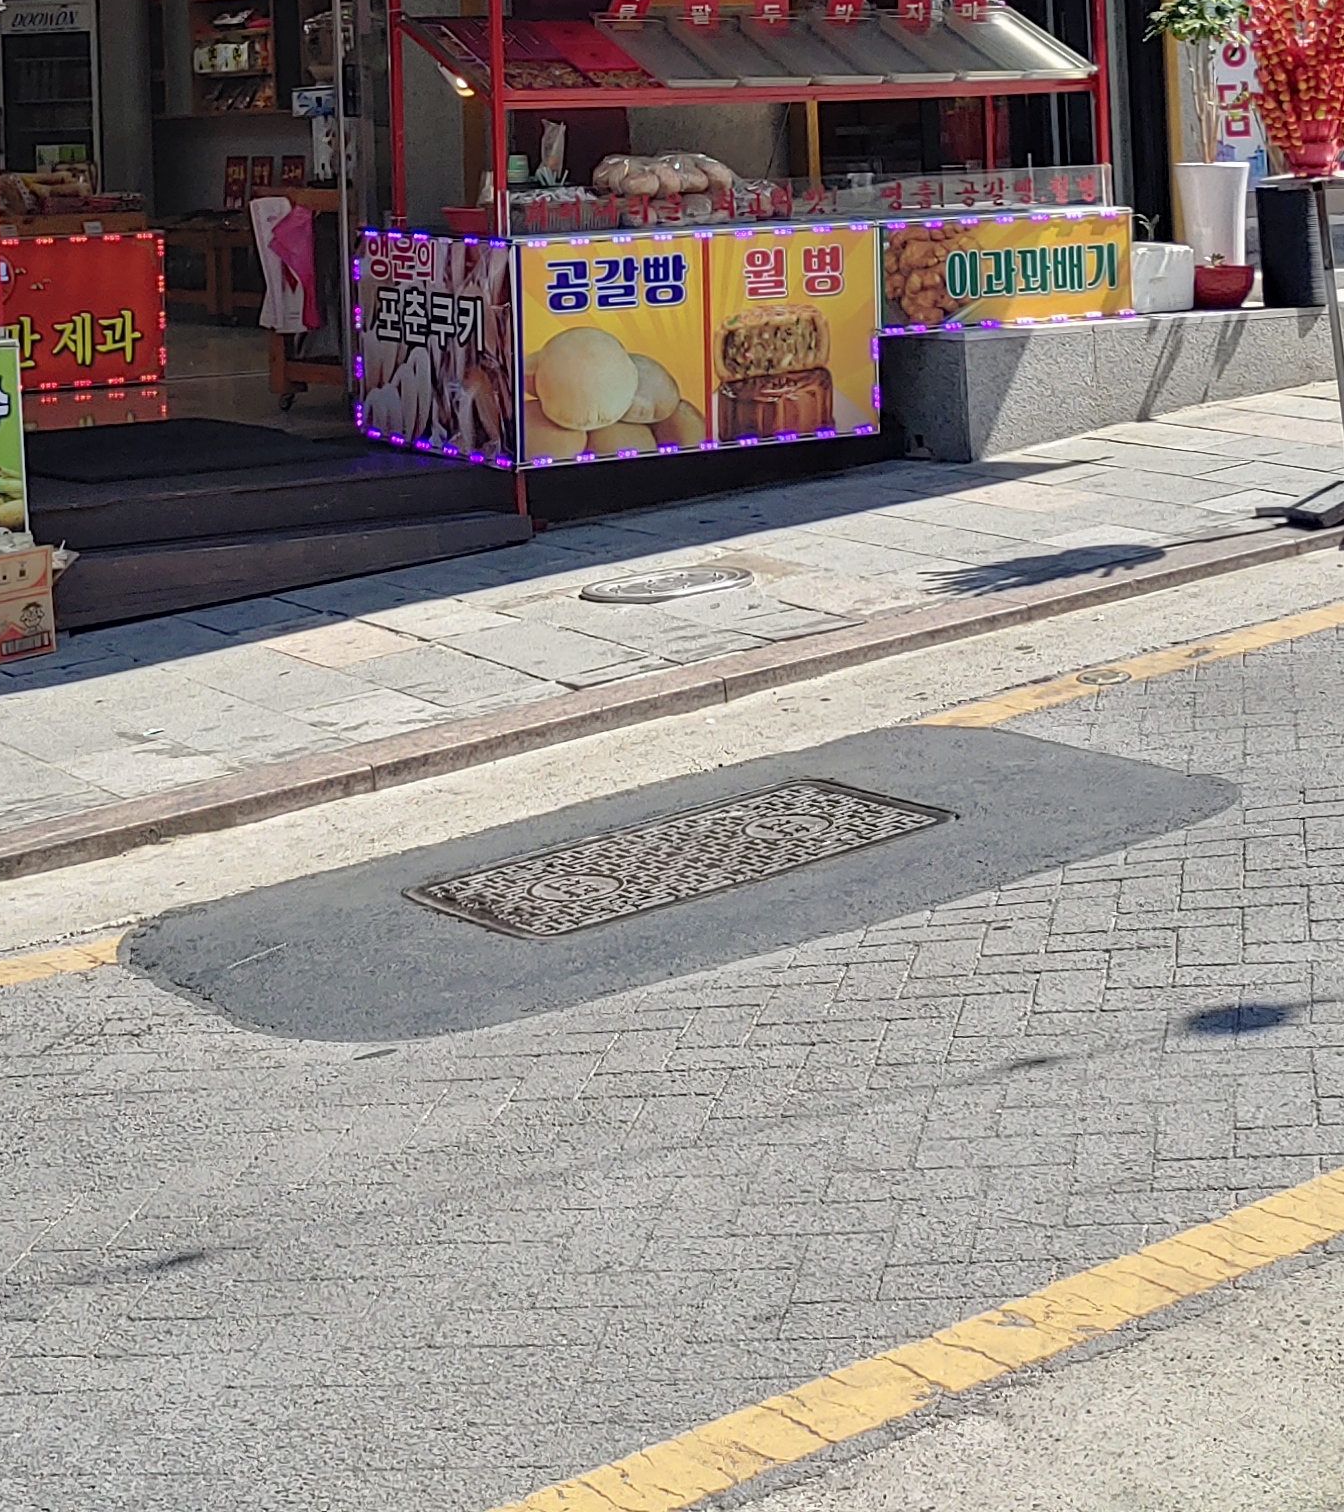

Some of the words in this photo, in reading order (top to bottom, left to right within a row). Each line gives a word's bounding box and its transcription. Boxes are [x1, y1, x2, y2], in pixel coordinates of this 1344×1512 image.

[367, 237, 436, 282] 행운의
[546, 253, 688, 314] 공갈빵
[53, 310, 142, 366] 제과
[377, 288, 484, 352] 포춘쿠키
